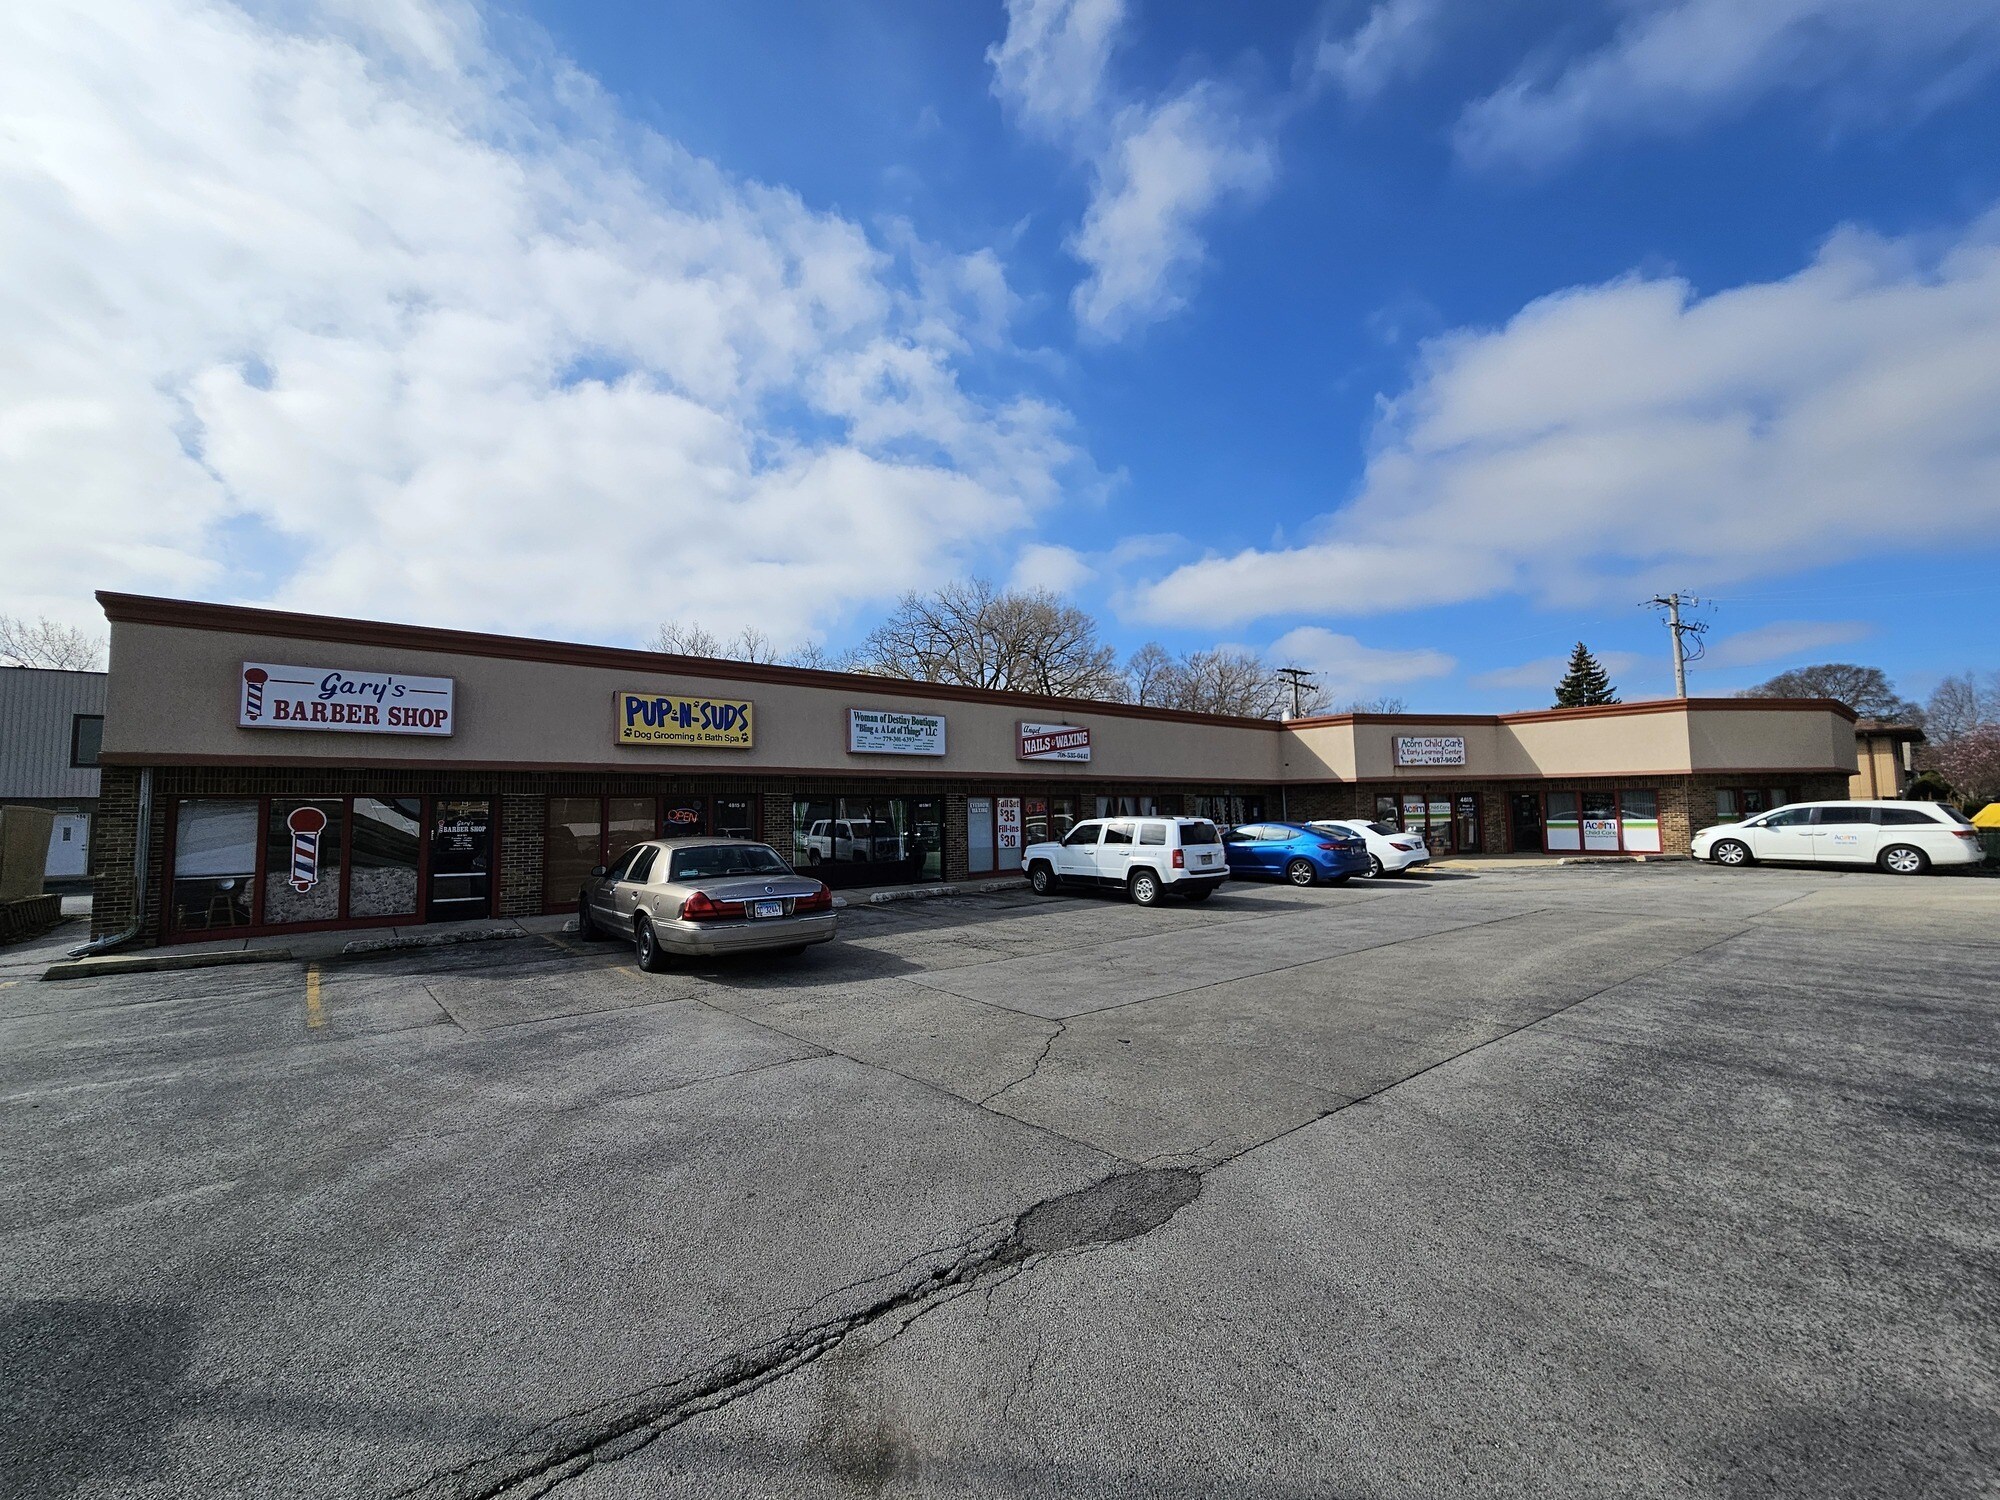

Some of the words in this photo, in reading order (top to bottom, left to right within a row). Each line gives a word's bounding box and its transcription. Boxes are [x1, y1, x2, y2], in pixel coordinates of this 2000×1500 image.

[318, 672, 406, 703] Gary's
[273, 700, 380, 725] BARBER
[388, 706, 448, 728] SHOP
[625, 696, 749, 732] PUP-N-SUDS
[853, 711, 879, 723] Woman
[880, 714, 887, 723] of
[887, 714, 911, 726] Destiny
[911, 716, 938, 729] Boutique
[634, 730, 651, 740] Dog
[654, 731, 695, 741] Grooming
[724, 734, 739, 743] Spa
[881, 725, 886, 734] A
[886, 725, 896, 734] Lot
[897, 726, 903, 735] of
[925, 728, 938, 737] LLC
[1023, 725, 1041, 735] Angel
[1024, 736, 1051, 753] NAILS
[1055, 732, 1088, 748] WAXING
[1401, 737, 1423, 748] Acorn
[1424, 739, 1442, 748] Child
[1444, 739, 1463, 748] Care
[1421, 748, 1444, 756] Learning
[998, 800, 1009, 808] Full
[1009, 800, 1019, 808] Set
[1404, 804, 1425, 814] Acorn
[667, 809, 698, 823] OPEN
[1000, 808, 1015, 822] $35
[999, 825, 1019, 833] Fill-Ins
[1585, 821, 1616, 830] Acorn
[1001, 834, 1016, 847] $30
